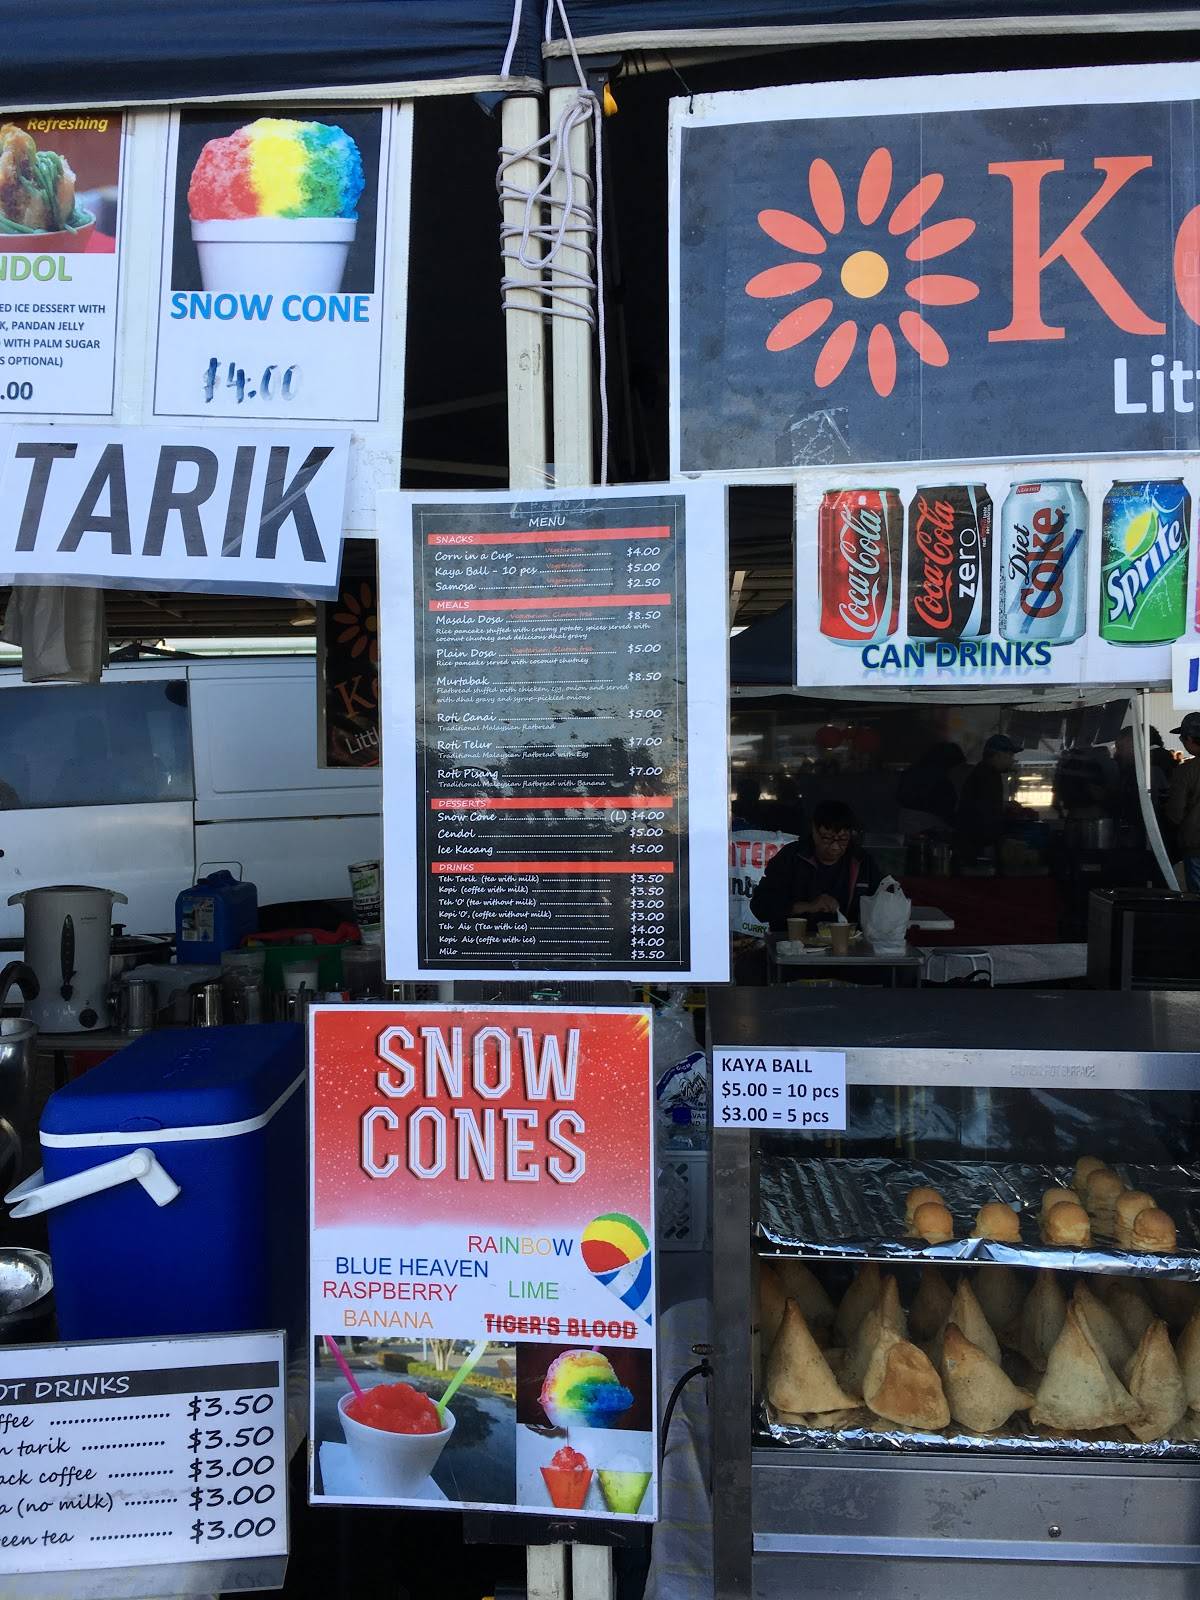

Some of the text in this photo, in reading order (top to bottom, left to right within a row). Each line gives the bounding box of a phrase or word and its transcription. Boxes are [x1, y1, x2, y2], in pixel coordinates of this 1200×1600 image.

[27, 116, 108, 133] Refreshing
[14, 303, 30, 313] ICE
[32, 303, 76, 313] DESSERT
[78, 304, 106, 314] WITH
[170, 293, 370, 322] SNOW CONE
[11, 321, 85, 331] PANDAN JELLY
[4, 338, 101, 349] WITH PALM SUGAR
[8, 356, 63, 368] OPTIONAL)
[1114, 354, 1200, 414] Lit
[14, 442, 335, 563] TARIK
[528, 516, 566, 528] MENU
[435, 535, 474, 544] SNACKS
[435, 551, 463, 561] Corn
[465, 551, 478, 560] in
[491, 551, 514, 562] Cup
[626, 547, 660, 557] $4.00
[1008, 523, 1030, 585] Diet
[435, 563, 660, 578] Kaya Ball 10 pcs $5.00
[959, 528, 976, 598] zero
[1020, 507, 1066, 619] Coke
[1107, 518, 1183, 623] Sprite
[435, 578, 661, 591] Samosa $2.50
[437, 601, 470, 609] MEALS
[436, 615, 475, 625] Masala
[478, 615, 504, 625] Dosa
[627, 610, 661, 621] $8.50
[436, 643, 661, 658] Plain Dosa $5.00
[860, 641, 1052, 669] CAN DRINKS
[436, 672, 662, 686] Murtabak $8.50
[437, 709, 662, 722] Roti Canai $5.00
[437, 736, 662, 750] Roti Telur $7.00
[437, 766, 663, 780] Roti Pisang $7.00
[438, 800, 486, 808] DESSERTS
[437, 810, 665, 823] Snow Cone (L) $4.00
[437, 827, 664, 839] Cendol $5.00
[438, 843, 664, 856] Ice Kacang $5.00
[438, 875, 455, 883] Teh
[455, 875, 477, 883] Tarik
[481, 875, 496, 884] (tea
[518, 875, 540, 884] milk)
[630, 873, 664, 884] $3.50
[439, 886, 458, 894] Kopi
[460, 886, 486, 894] (coffee
[507, 886, 529, 894] milk)
[630, 886, 664, 896] $3.50
[466, 899, 482, 907] (tea
[483, 898, 514, 906] without
[515, 898, 537, 907] milk)
[630, 898, 664, 909] $3.00
[439, 911, 459, 919] Kopi
[472, 911, 497, 919] (coffee
[530, 911, 552, 919] milk)
[630, 911, 664, 921] $3.00
[475, 923, 493, 931] (Tea
[514, 923, 528, 932] ice)
[630, 924, 665, 935] $4.00
[439, 936, 458, 944] Kopi
[475, 936, 501, 945] (coffee
[522, 936, 536, 944] ice)
[630, 936, 665, 947] $4.00
[630, 949, 665, 960] $3.50
[376, 1025, 581, 1101] SNOW
[721, 1058, 813, 1073] KAYA BALL
[721, 1081, 839, 1101] $5.00 10 pcs
[721, 1105, 768, 1122] $3.00
[787, 1109, 797, 1122] 5
[802, 1111, 829, 1125] pcs
[360, 1105, 586, 1183] CONES
[468, 1236, 573, 1256] RAINBOW
[336, 1257, 488, 1278] BLUE HEAVEN
[323, 1281, 458, 1301] RASPBERRY
[509, 1280, 559, 1299] LIME
[344, 1310, 434, 1328] BANANA
[485, 1314, 638, 1339] TIGER'S BLOOD
[35, 1376, 130, 1398] DRINKS
[187, 1394, 273, 1421] $3.50
[17, 1426, 274, 1456] tarik $3.50
[39, 1466, 97, 1487] coffee
[188, 1457, 275, 1482] $3.00
[17, 1498, 53, 1518] (no
[59, 1492, 113, 1512] milk)
[188, 1486, 275, 1511] $3.00
[42, 1530, 74, 1546] tea
[190, 1517, 276, 1544] $3.00
